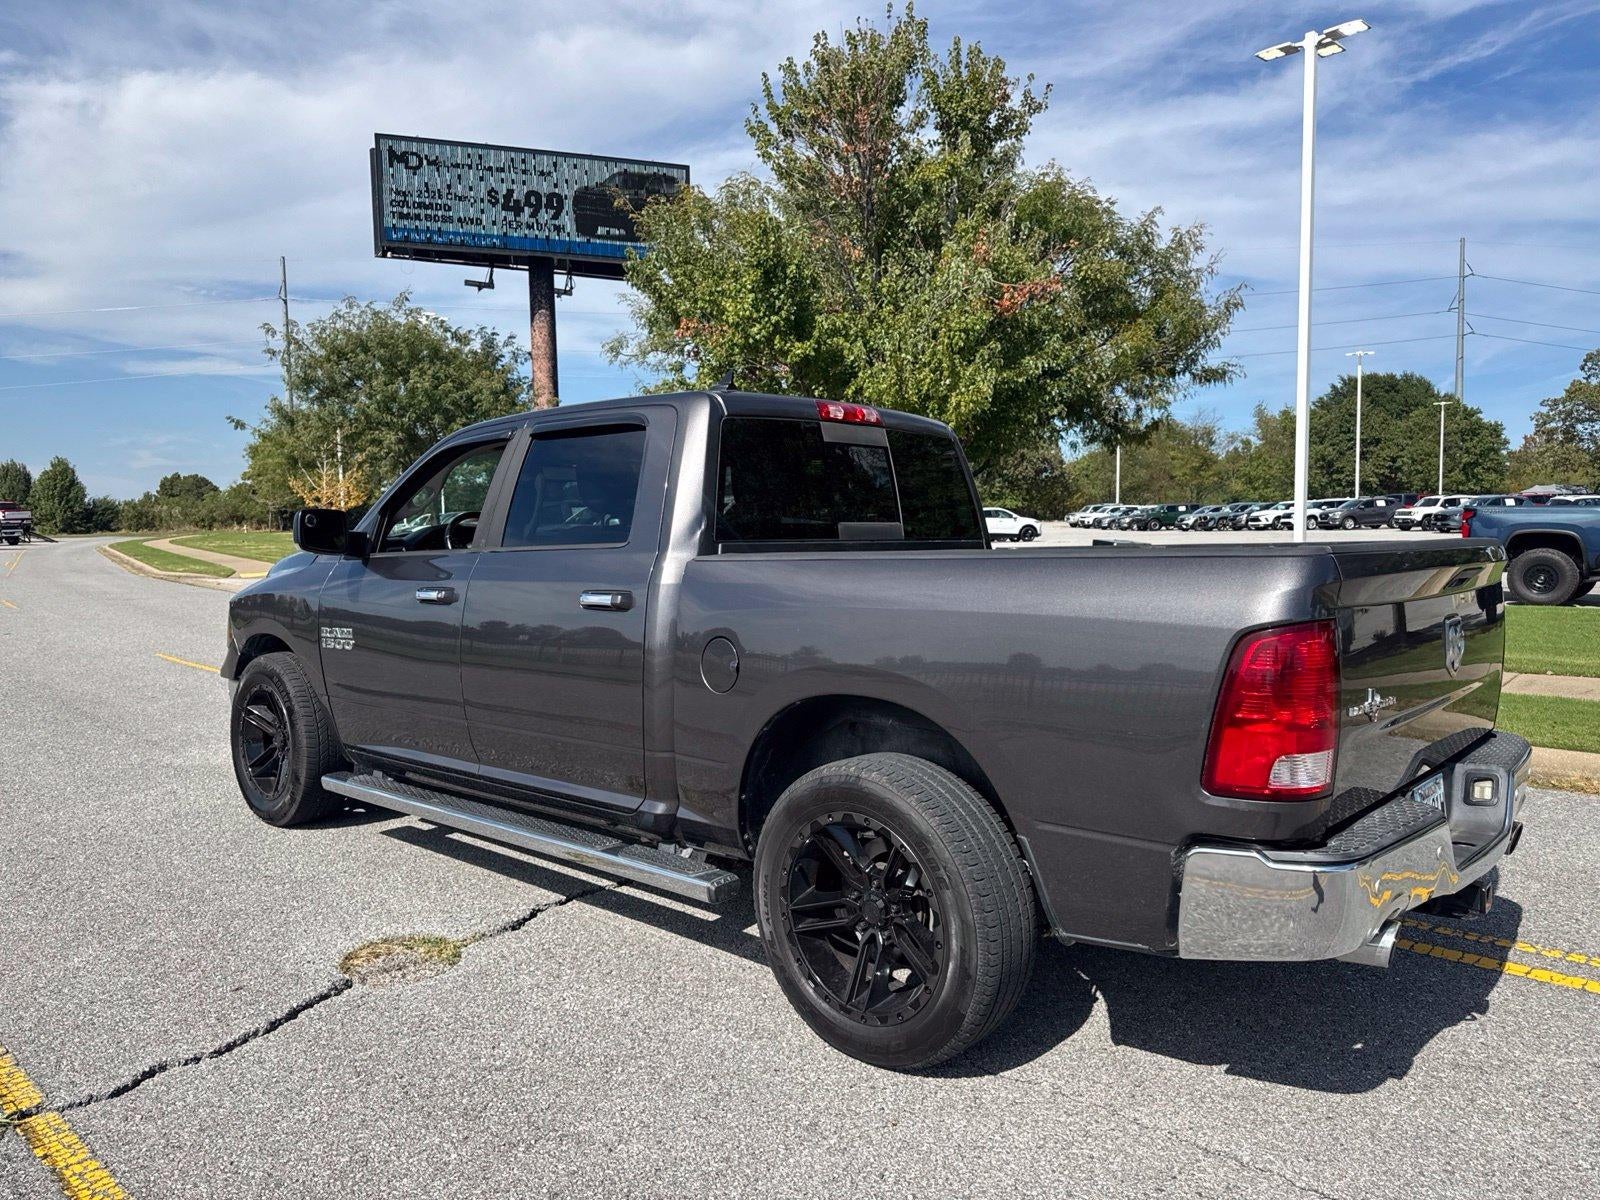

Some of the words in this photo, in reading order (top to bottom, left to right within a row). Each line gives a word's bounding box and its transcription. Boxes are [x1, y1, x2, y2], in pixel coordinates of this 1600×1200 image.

[487, 187, 565, 220] $499
[424, 213, 453, 223] BOSS
[320, 627, 353, 638] RAM
[321, 638, 355, 651] 1500
